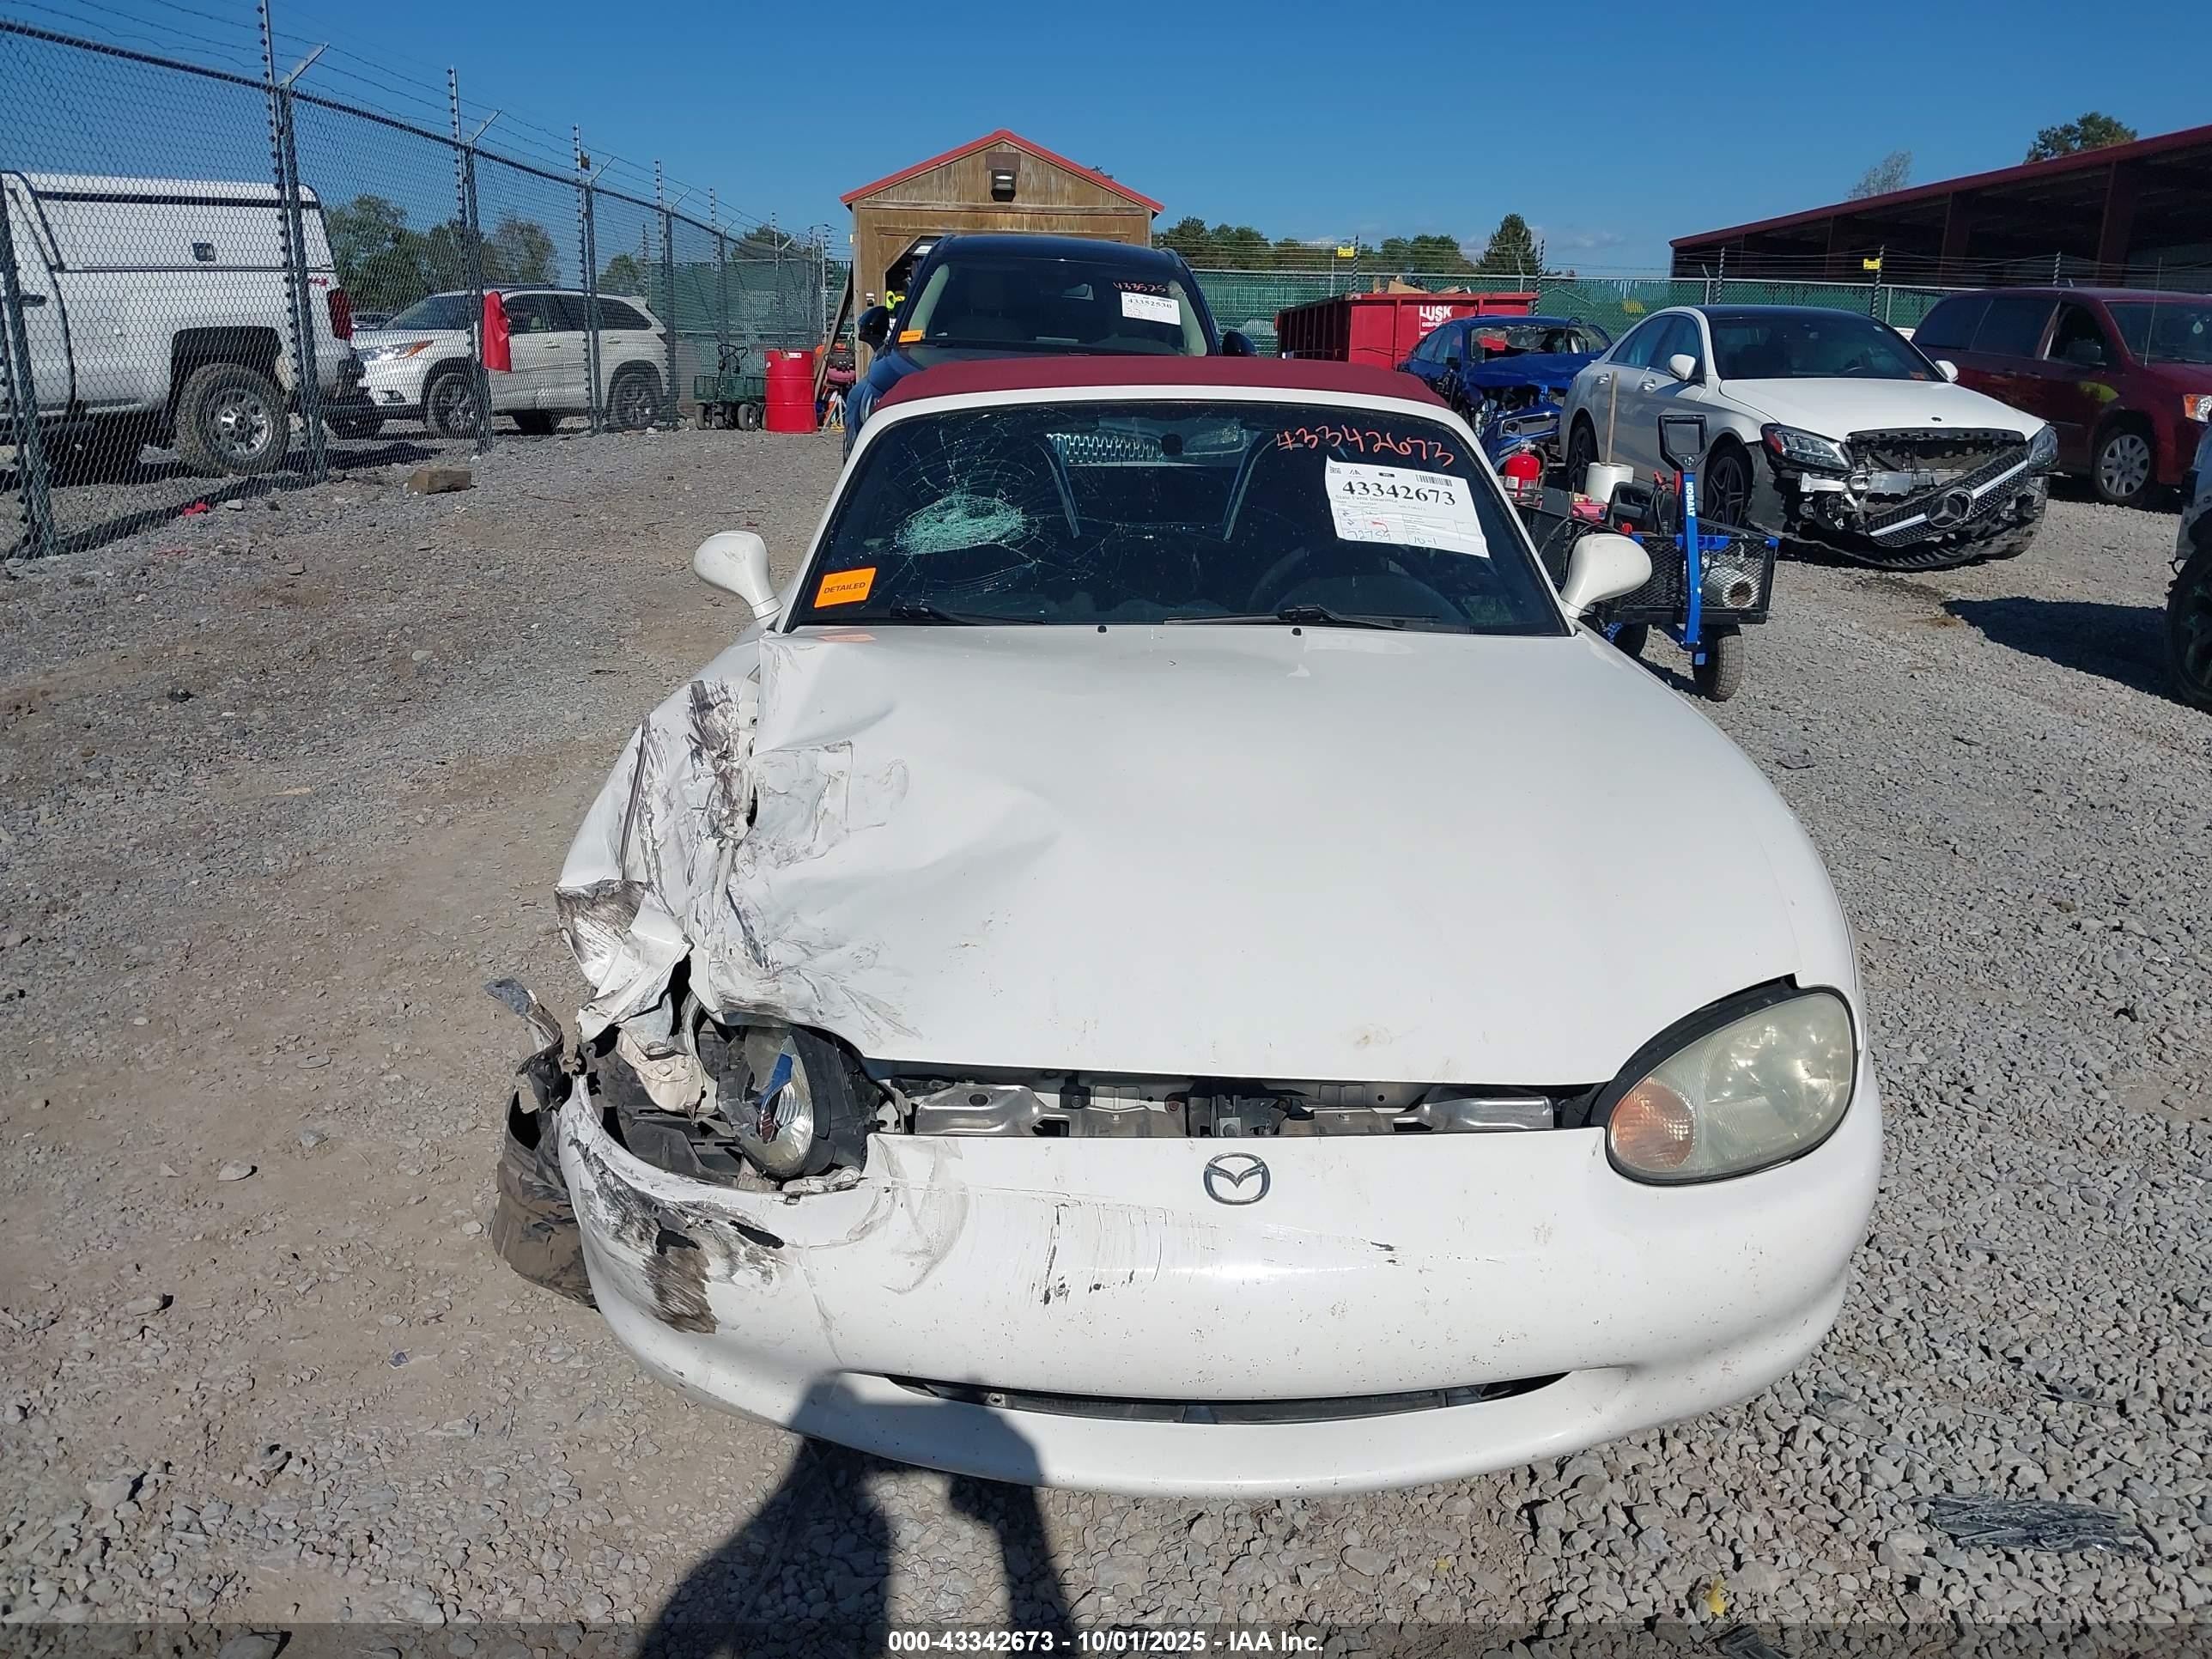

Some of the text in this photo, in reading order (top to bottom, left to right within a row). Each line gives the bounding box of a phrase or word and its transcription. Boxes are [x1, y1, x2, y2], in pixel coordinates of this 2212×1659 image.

[1419, 305, 1452, 322] LUSK
[1276, 424, 1455, 466] 43342673
[1343, 480, 1456, 506] 43342673
[1686, 482, 1695, 517] KOBALT
[823, 581, 866, 594] DETAILED
